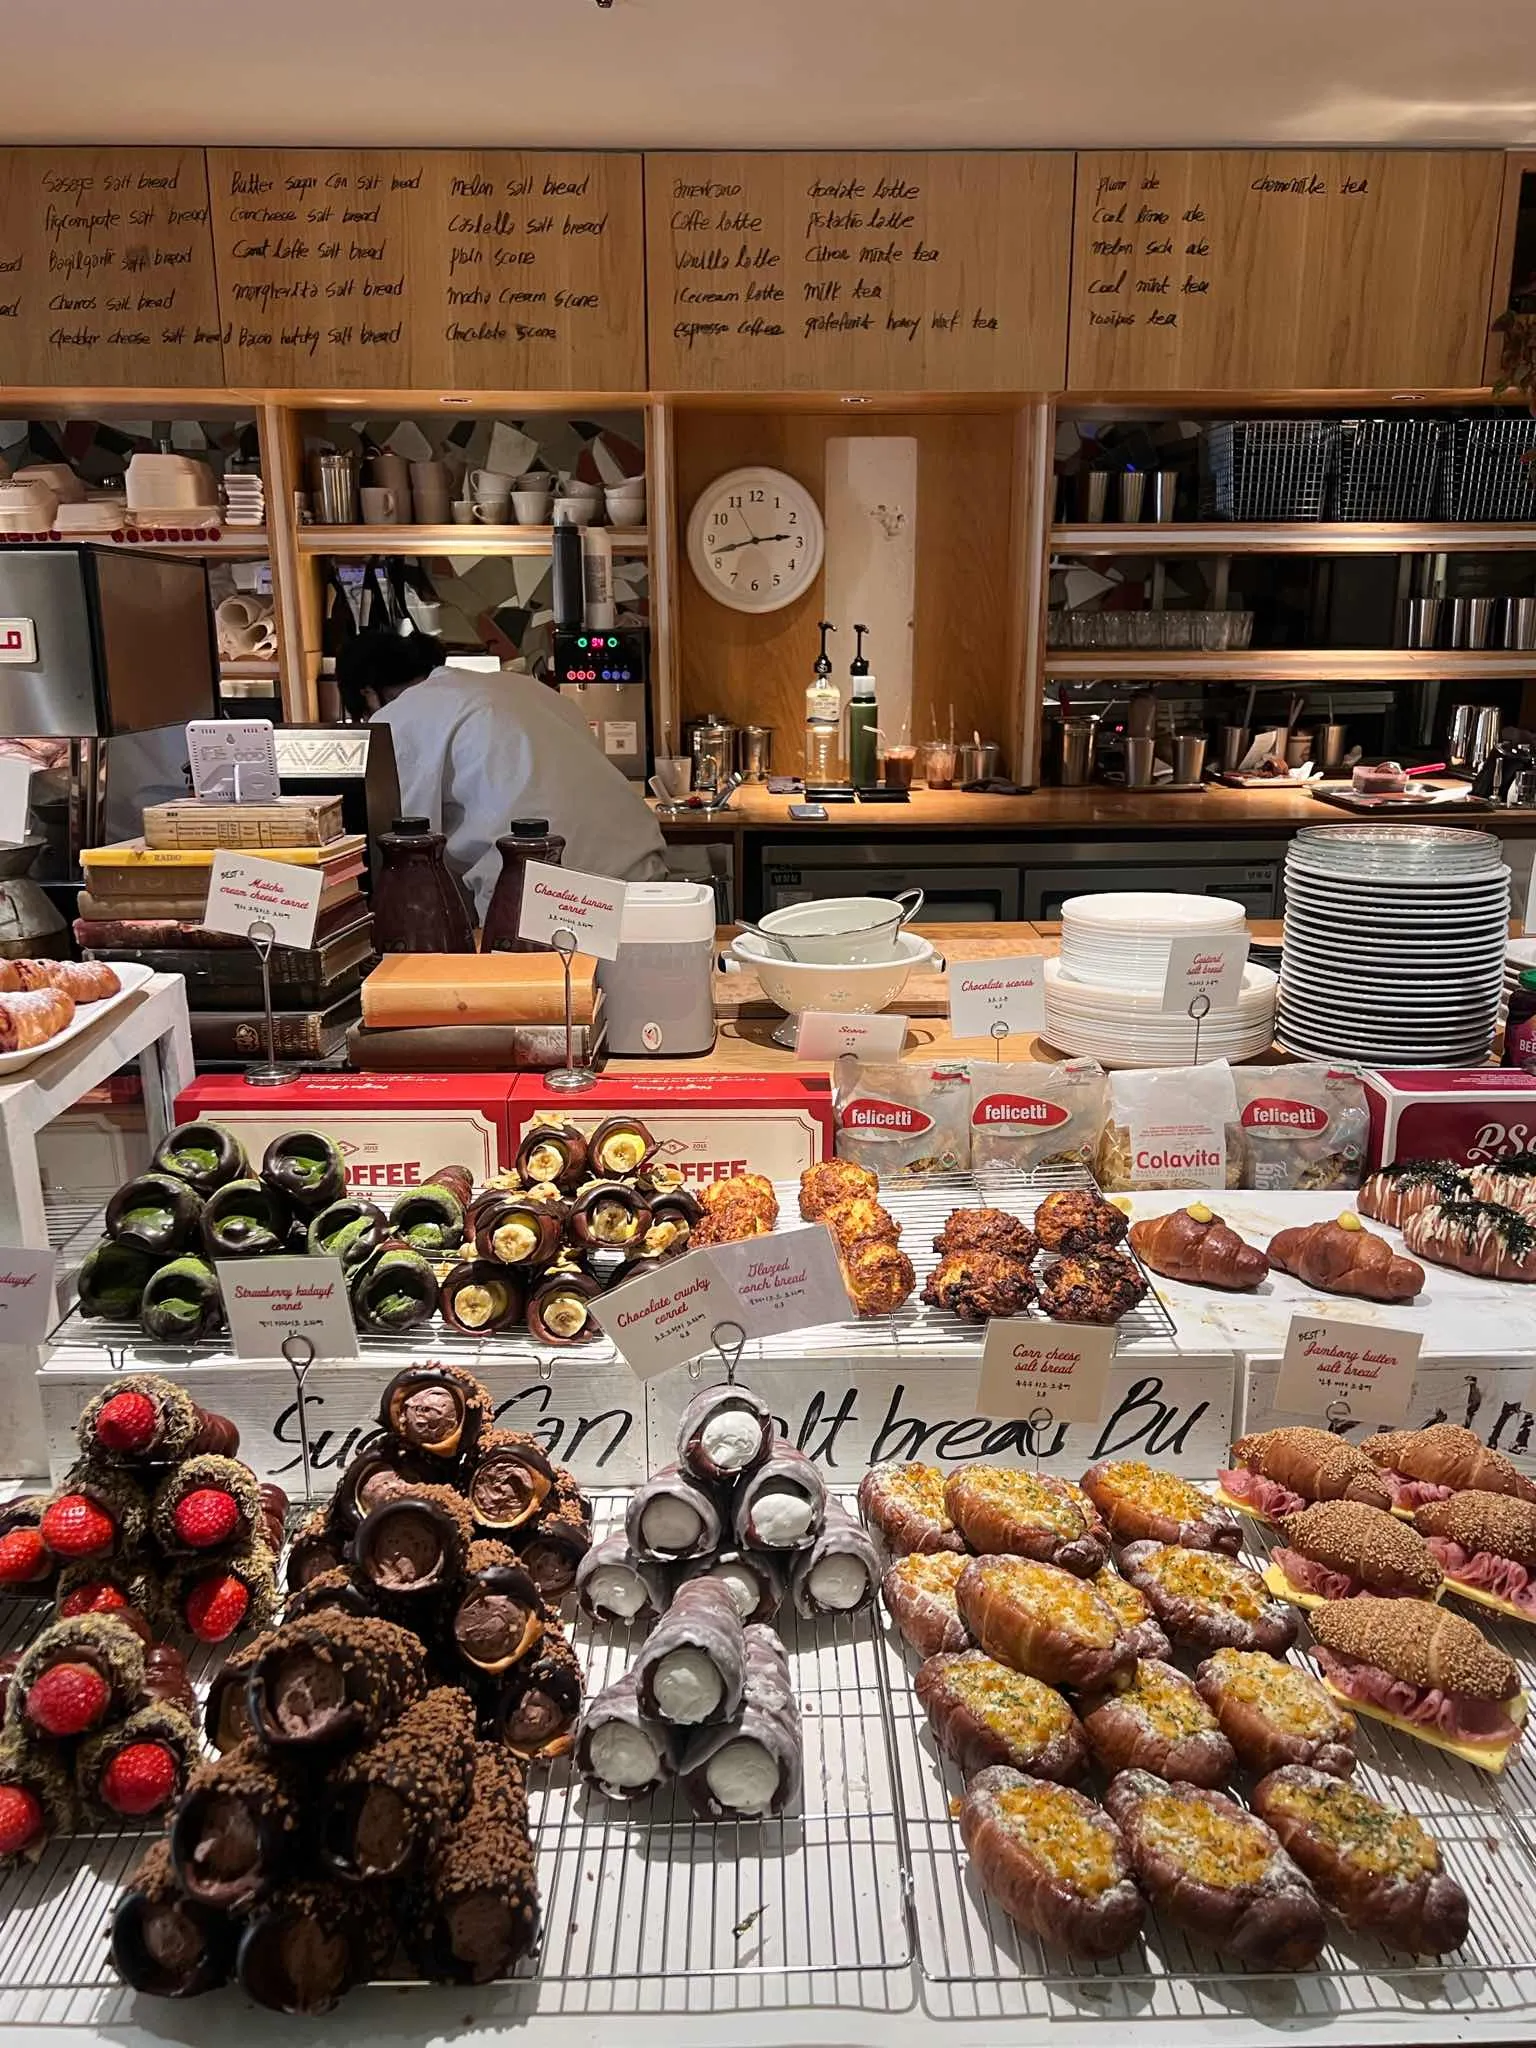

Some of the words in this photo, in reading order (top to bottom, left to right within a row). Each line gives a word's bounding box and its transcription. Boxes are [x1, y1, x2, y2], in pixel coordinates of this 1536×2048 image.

[543, 175, 589, 196] bread
[1340, 176, 1368, 194] tea
[564, 213, 608, 235] bread
[364, 275, 405, 297] bread
[852, 278, 882, 300] tea
[1181, 274, 1209, 294] tea
[138, 288, 176, 311] bread
[973, 308, 998, 330] tea
[1147, 309, 1178, 328] tea
[361, 322, 402, 345] bread
[729, 497, 742, 508] 11
[750, 490, 764, 502] 12
[713, 513, 728, 525] 10
[788, 513, 797, 524] 2
[707, 535, 715, 545] 9
[796, 536, 803, 548] 3
[714, 558, 722, 568] 8
[788, 559, 795, 570] 4
[730, 572, 738, 584] 7
[751, 580, 759, 591] 6
[773, 575, 780, 586] 5
[249, 879, 285, 893] Matcha
[220, 886, 247, 897] cream
[250, 891, 278, 904] cheese
[280, 896, 310, 910] cornet
[534, 883, 578, 903] Chocolate
[581, 896, 614, 911] banana
[558, 904, 587, 915] cornet
[1186, 964, 1201, 975] salt
[1202, 964, 1224, 974] bread
[962, 980, 1004, 992] Chocolate
[852, 1109, 912, 1125] felicetti
[985, 1104, 1047, 1120] felicetti
[1254, 1108, 1316, 1123] felicetti
[1136, 1150, 1220, 1169] Colavita
[344, 1162, 421, 1184] FFEE
[640, 1160, 747, 1182] FFEE
[774, 1271, 807, 1288] bread
[235, 1285, 293, 1299] Strawberry
[272, 1302, 303, 1311] cornet
[617, 1293, 671, 1328] Chocolate
[655, 1304, 689, 1326] cornet
[1012, 1344, 1042, 1359] Corn
[1046, 1347, 1081, 1362] cheese
[1363, 1350, 1399, 1365] butter
[1015, 1359, 1037, 1372] salt
[1041, 1361, 1075, 1374] bread
[1317, 1361, 1341, 1374] salt
[1344, 1363, 1381, 1378] bread
[1088, 1377, 1210, 1459] Bu
